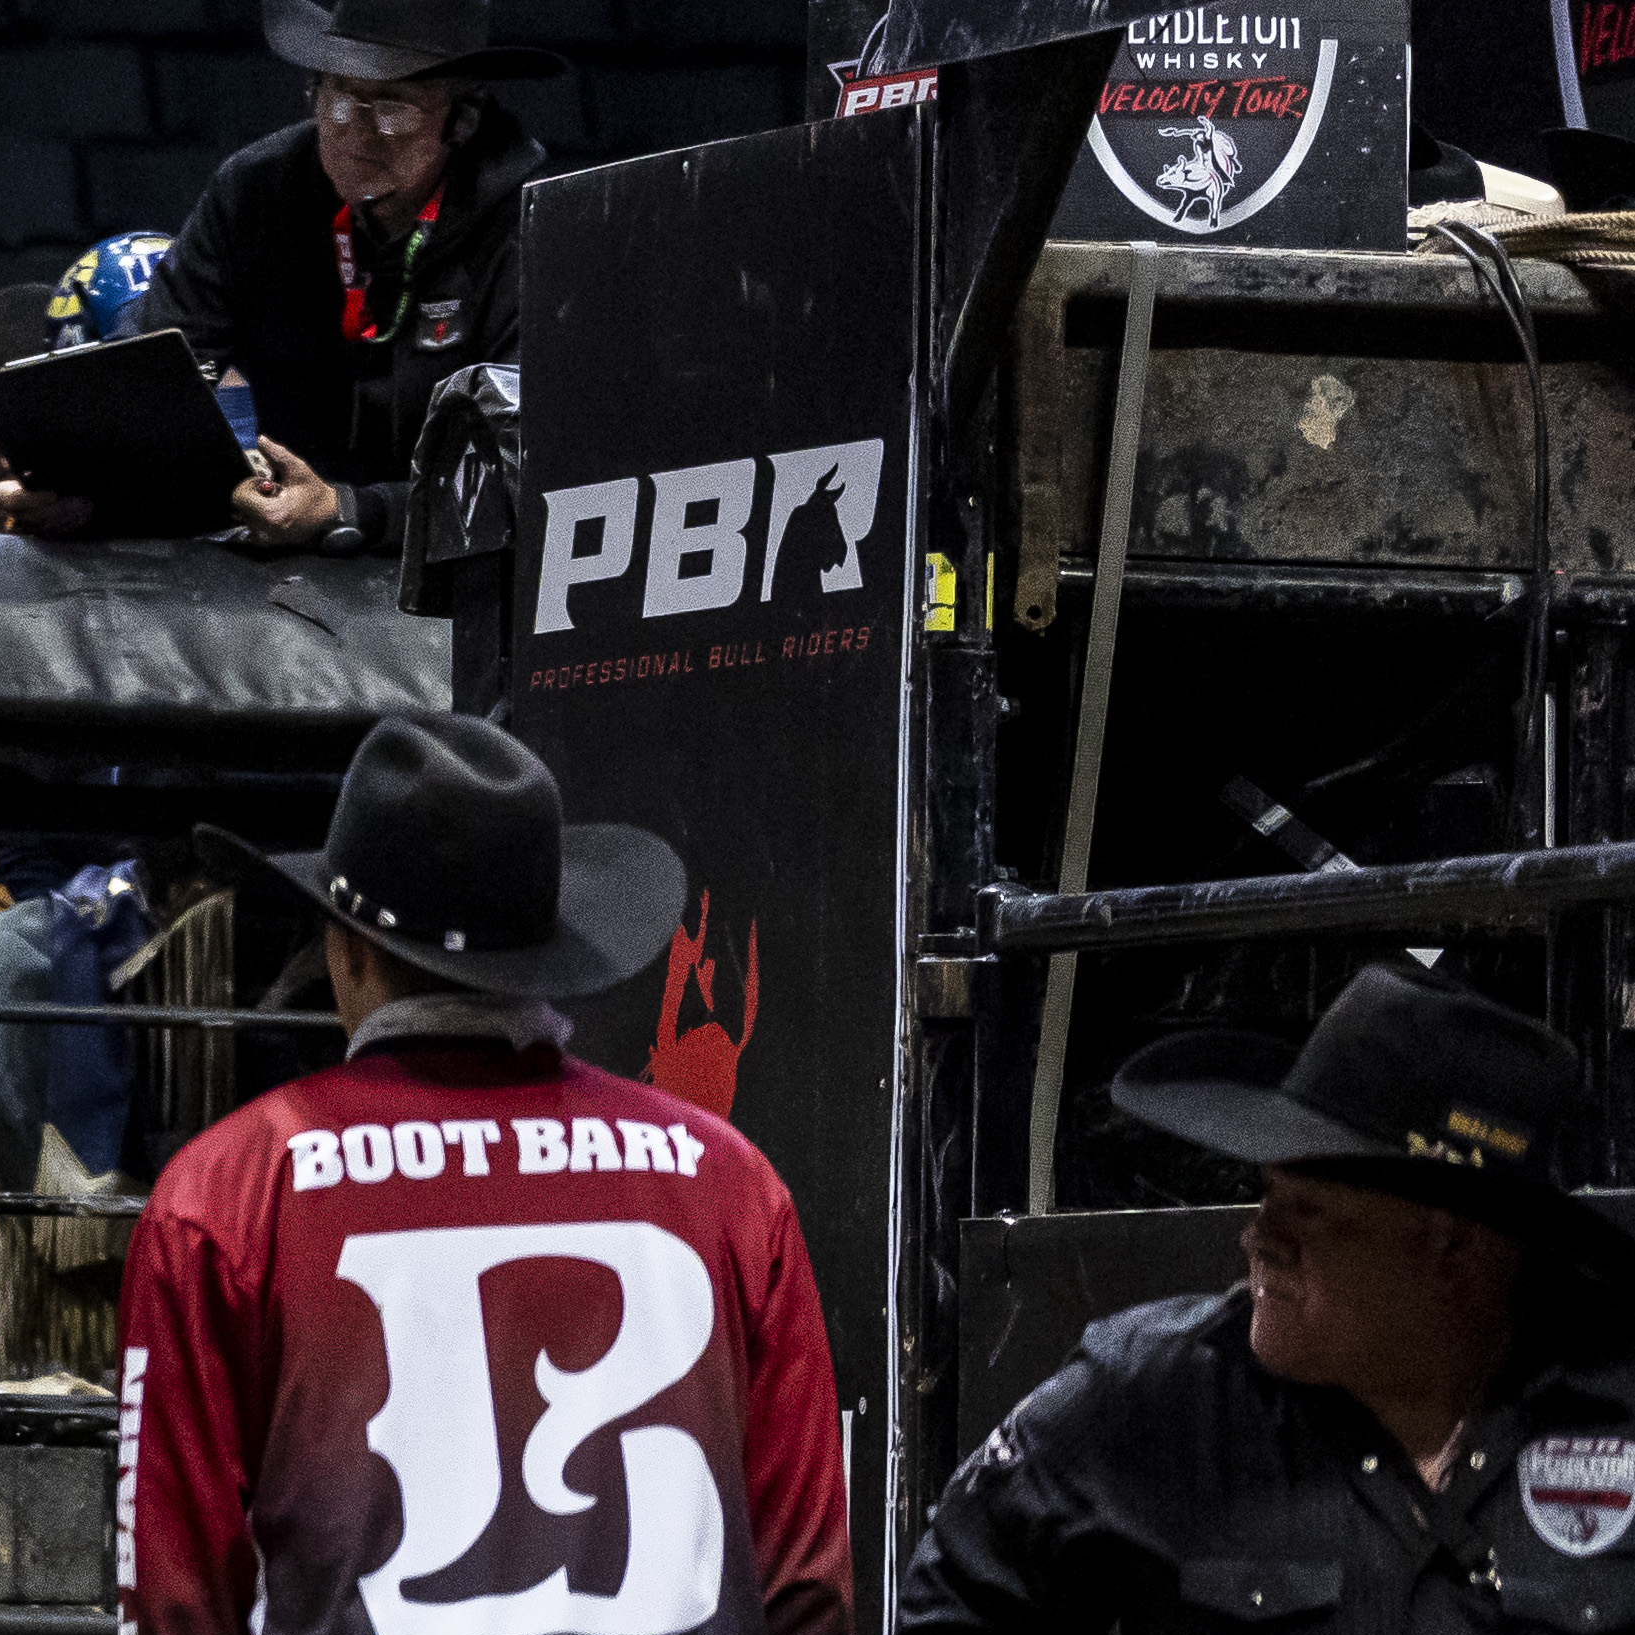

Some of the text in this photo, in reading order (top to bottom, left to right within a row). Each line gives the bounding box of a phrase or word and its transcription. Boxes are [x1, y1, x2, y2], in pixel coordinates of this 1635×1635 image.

[1136, 52, 1268, 69] WHISKY
[1097, 79, 1226, 118] VELOCITY
[534, 438, 884, 634] PBR
[529, 626, 870, 691] PROFESSIONAL BULL RIDERS
[287, 1119, 501, 1192] BOOT
